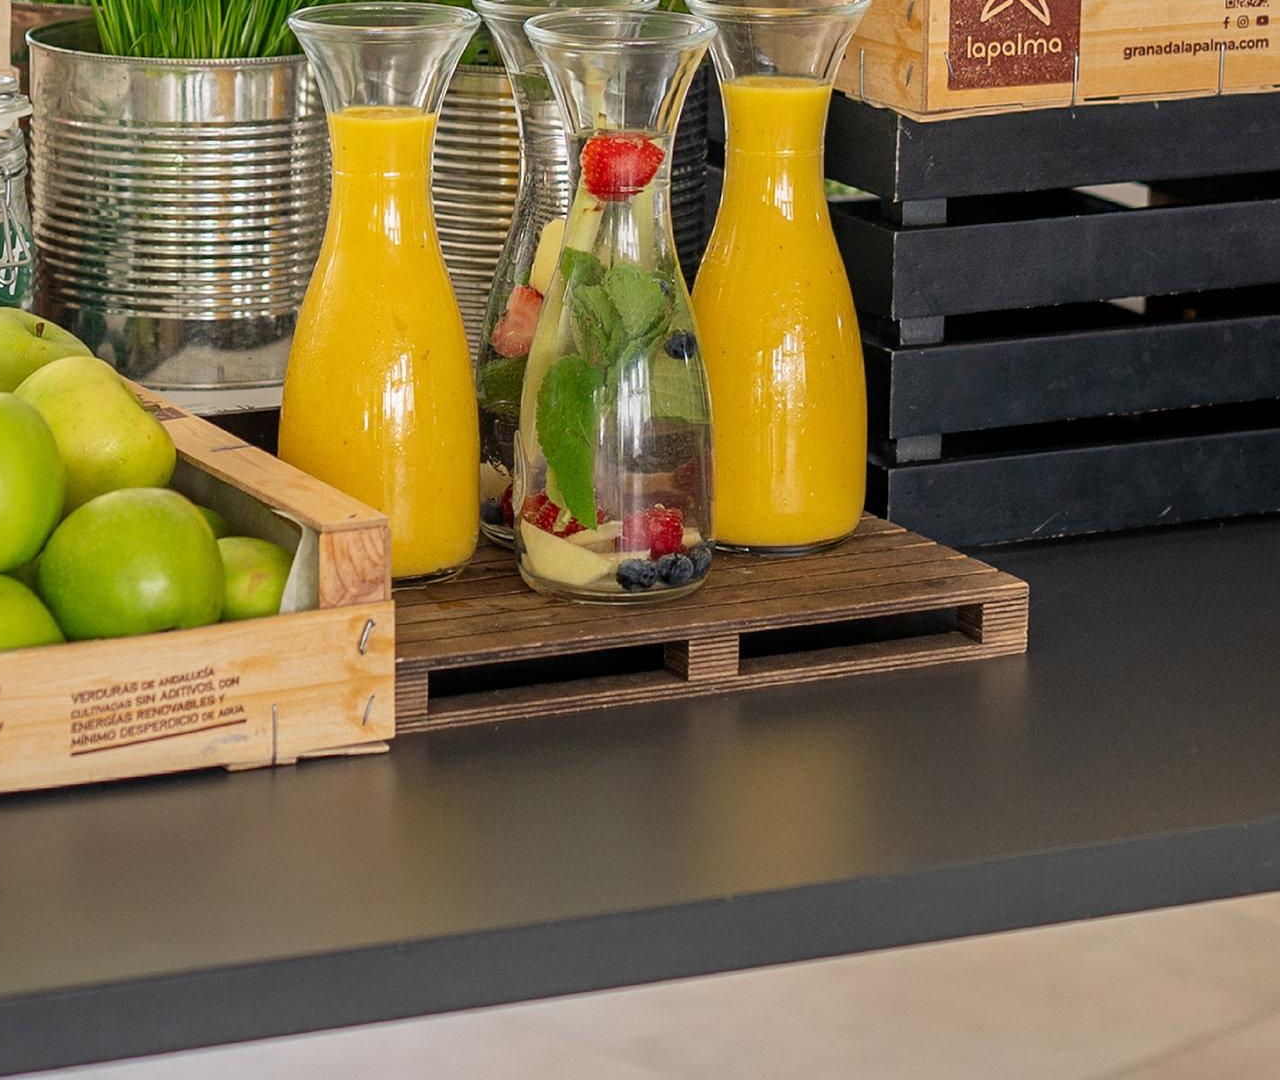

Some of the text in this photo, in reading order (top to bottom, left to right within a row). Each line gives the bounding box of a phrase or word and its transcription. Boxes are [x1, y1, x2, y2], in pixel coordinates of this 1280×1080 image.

[967, 33, 1062, 66] lapalma
[1123, 37, 1269, 60] granadalapalma.com
[70, 667, 215, 704] VERDURAS DE ANDALUCÍA
[70, 700, 132, 720] CULTIVADAS
[135, 693, 155, 707] SIN
[70, 694, 225, 734] ENERGÍAS RENOVABLES Y
[70, 704, 245, 747] MÍNIMO DESPERDICIO DE AGUA
